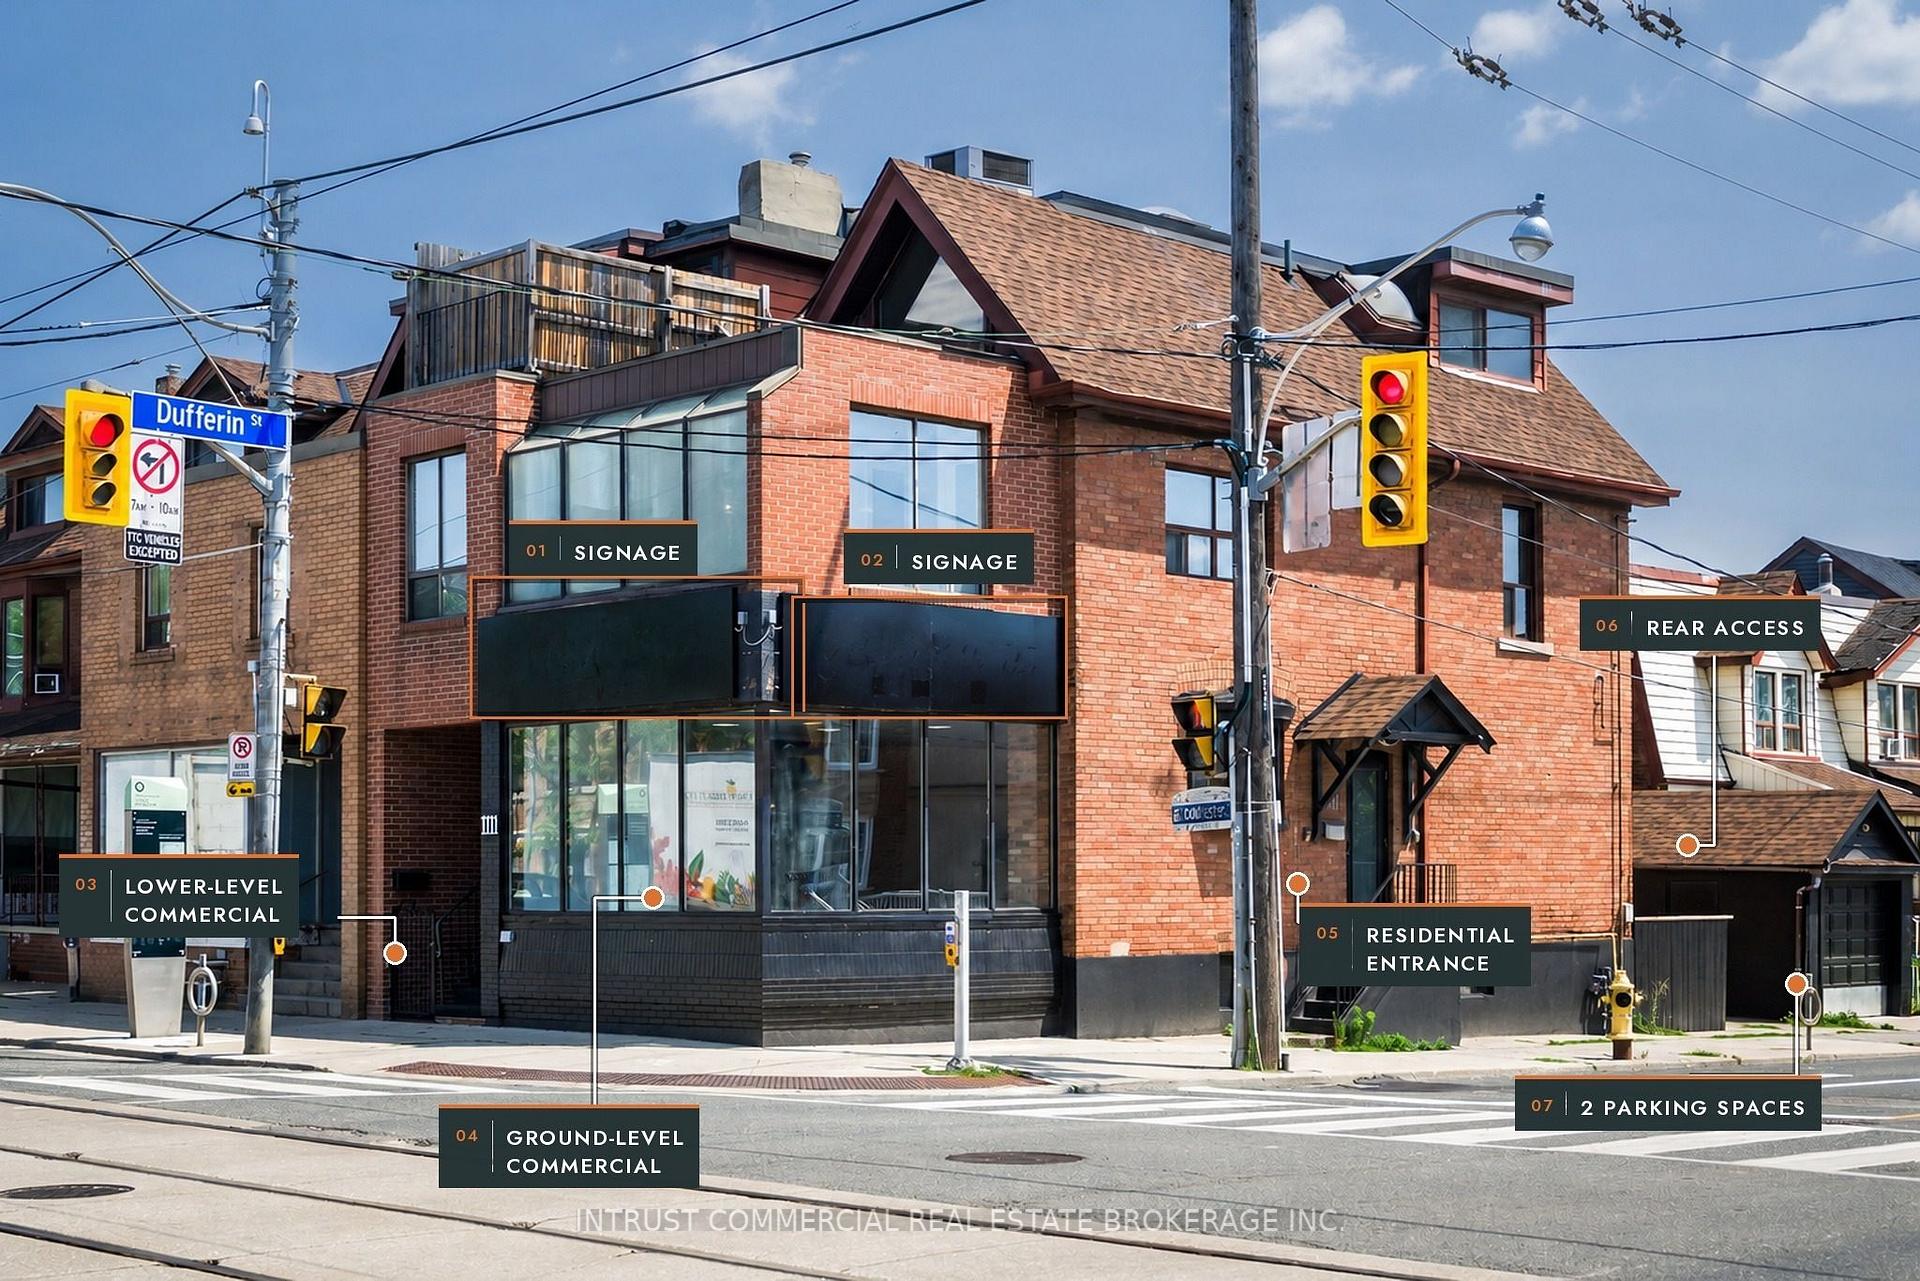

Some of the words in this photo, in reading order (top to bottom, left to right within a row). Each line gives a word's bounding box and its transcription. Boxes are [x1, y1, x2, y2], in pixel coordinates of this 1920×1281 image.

[157, 398, 245, 435] Dufferin
[250, 413, 262, 427] St
[127, 531, 142, 543] TTC
[129, 545, 178, 560] EXCEPTED
